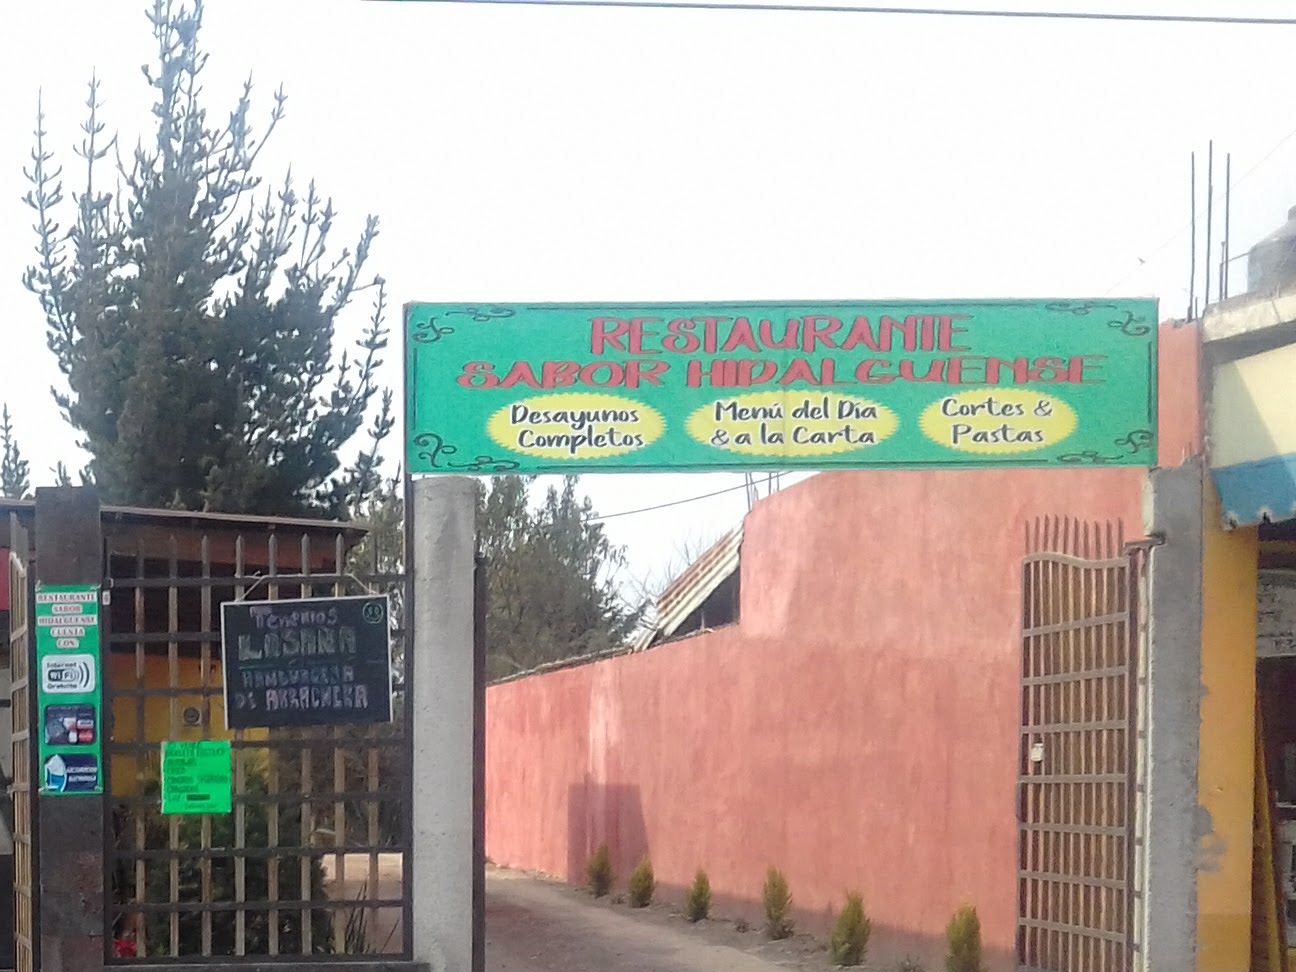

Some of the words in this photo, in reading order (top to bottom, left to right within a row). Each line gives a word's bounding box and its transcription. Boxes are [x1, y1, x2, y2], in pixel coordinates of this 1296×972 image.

[589, 315, 974, 354] RESTAURANTE
[455, 360, 671, 389] SABOR
[685, 355, 1108, 388] HIDALGUENSE
[510, 403, 640, 430] Desayunos
[714, 401, 784, 422] Menú
[792, 396, 830, 420] del
[837, 399, 877, 420] Día
[942, 398, 1024, 417] Cortes
[1032, 400, 1054, 417] &
[517, 424, 644, 454] Completos
[760, 422, 785, 445] la
[792, 424, 875, 445] Carta
[952, 423, 1044, 445] Pastas
